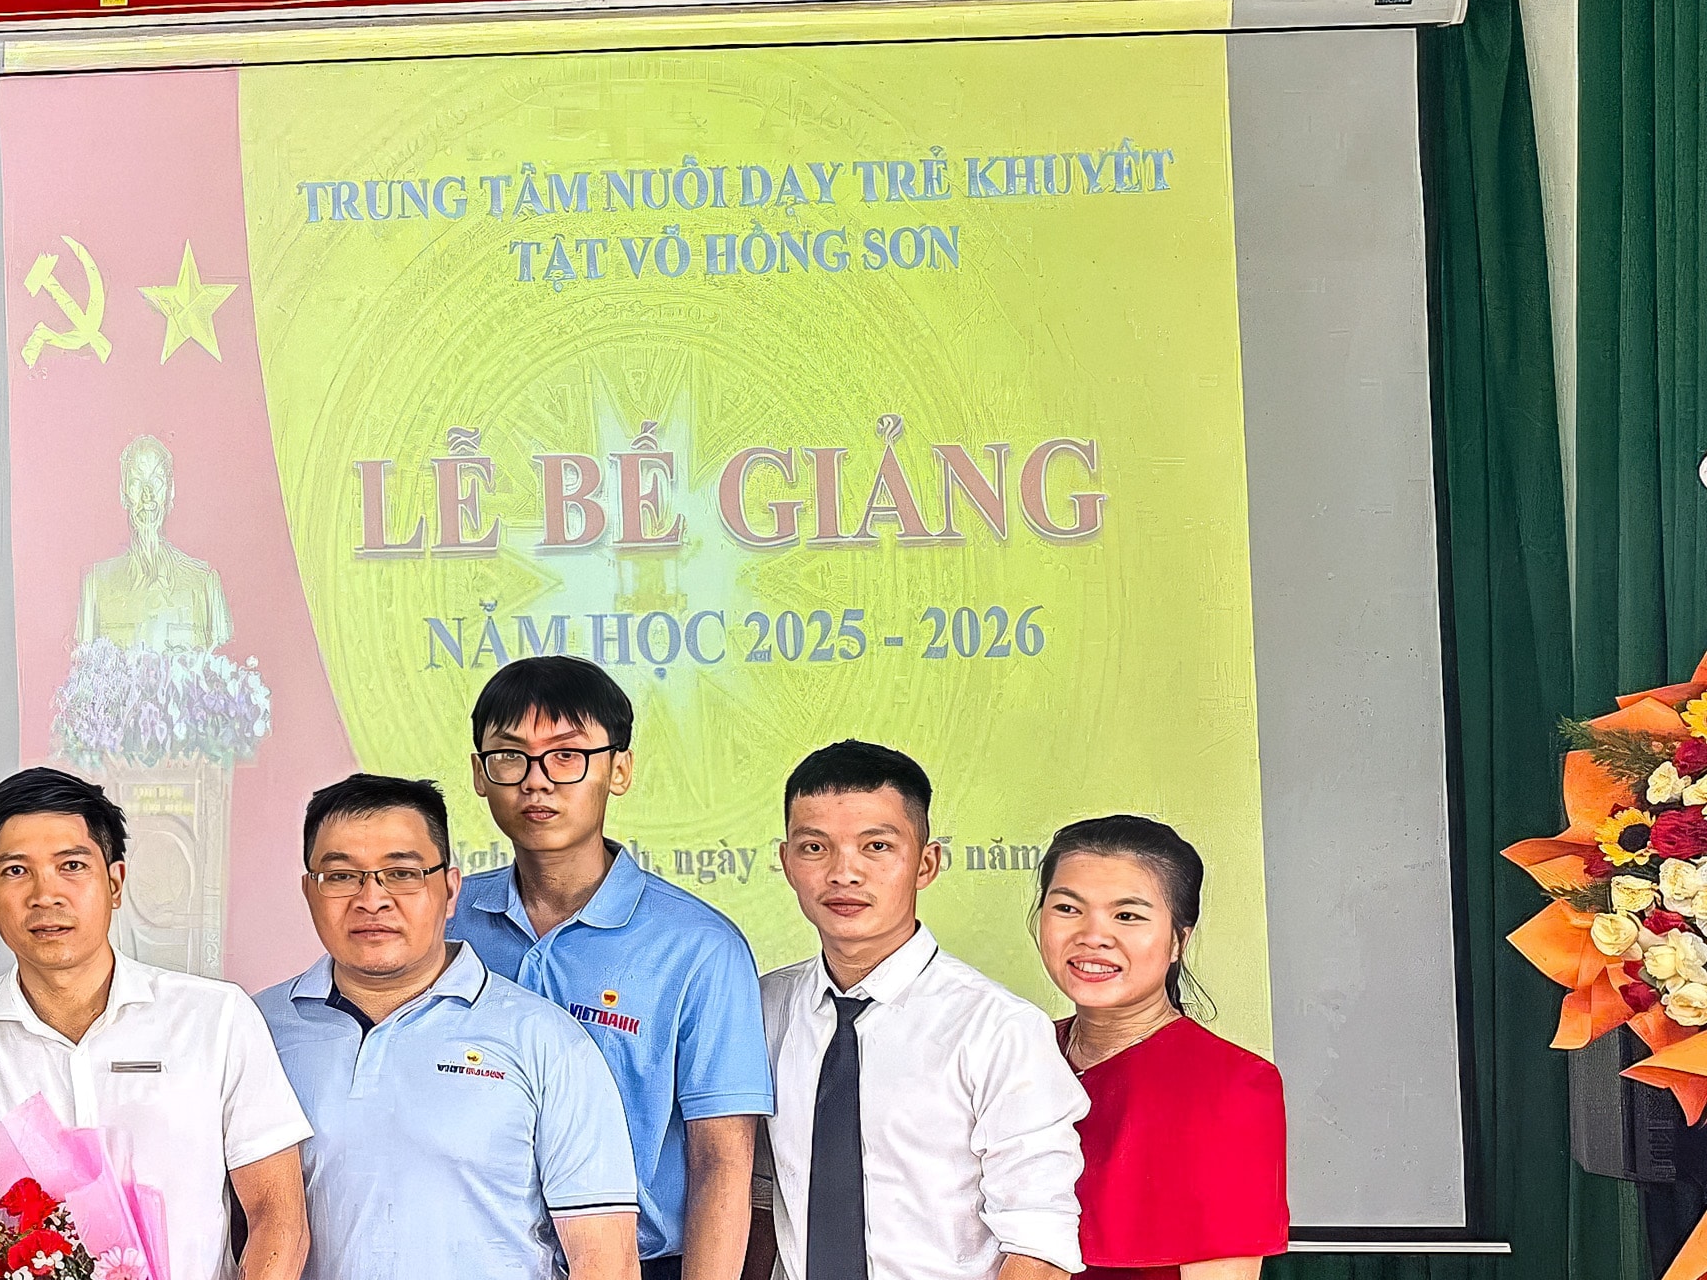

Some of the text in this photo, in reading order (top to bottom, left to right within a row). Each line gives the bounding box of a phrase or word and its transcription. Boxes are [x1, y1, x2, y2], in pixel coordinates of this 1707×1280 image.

[297, 175, 468, 224] TRUNG
[482, 161, 591, 218] TÂM
[729, 160, 844, 217] DẠY
[853, 145, 952, 203] TRẺ
[862, 226, 960, 272] SƠN
[353, 412, 1107, 557] LỄ BẾ GIẢNG
[423, 599, 571, 669] NĂM
[584, 610, 724, 680] HỌC
[744, 608, 867, 662] 2025
[919, 605, 1045, 659] 2026
[673, 839, 758, 884] ngày
[965, 836, 1041, 871] năm
